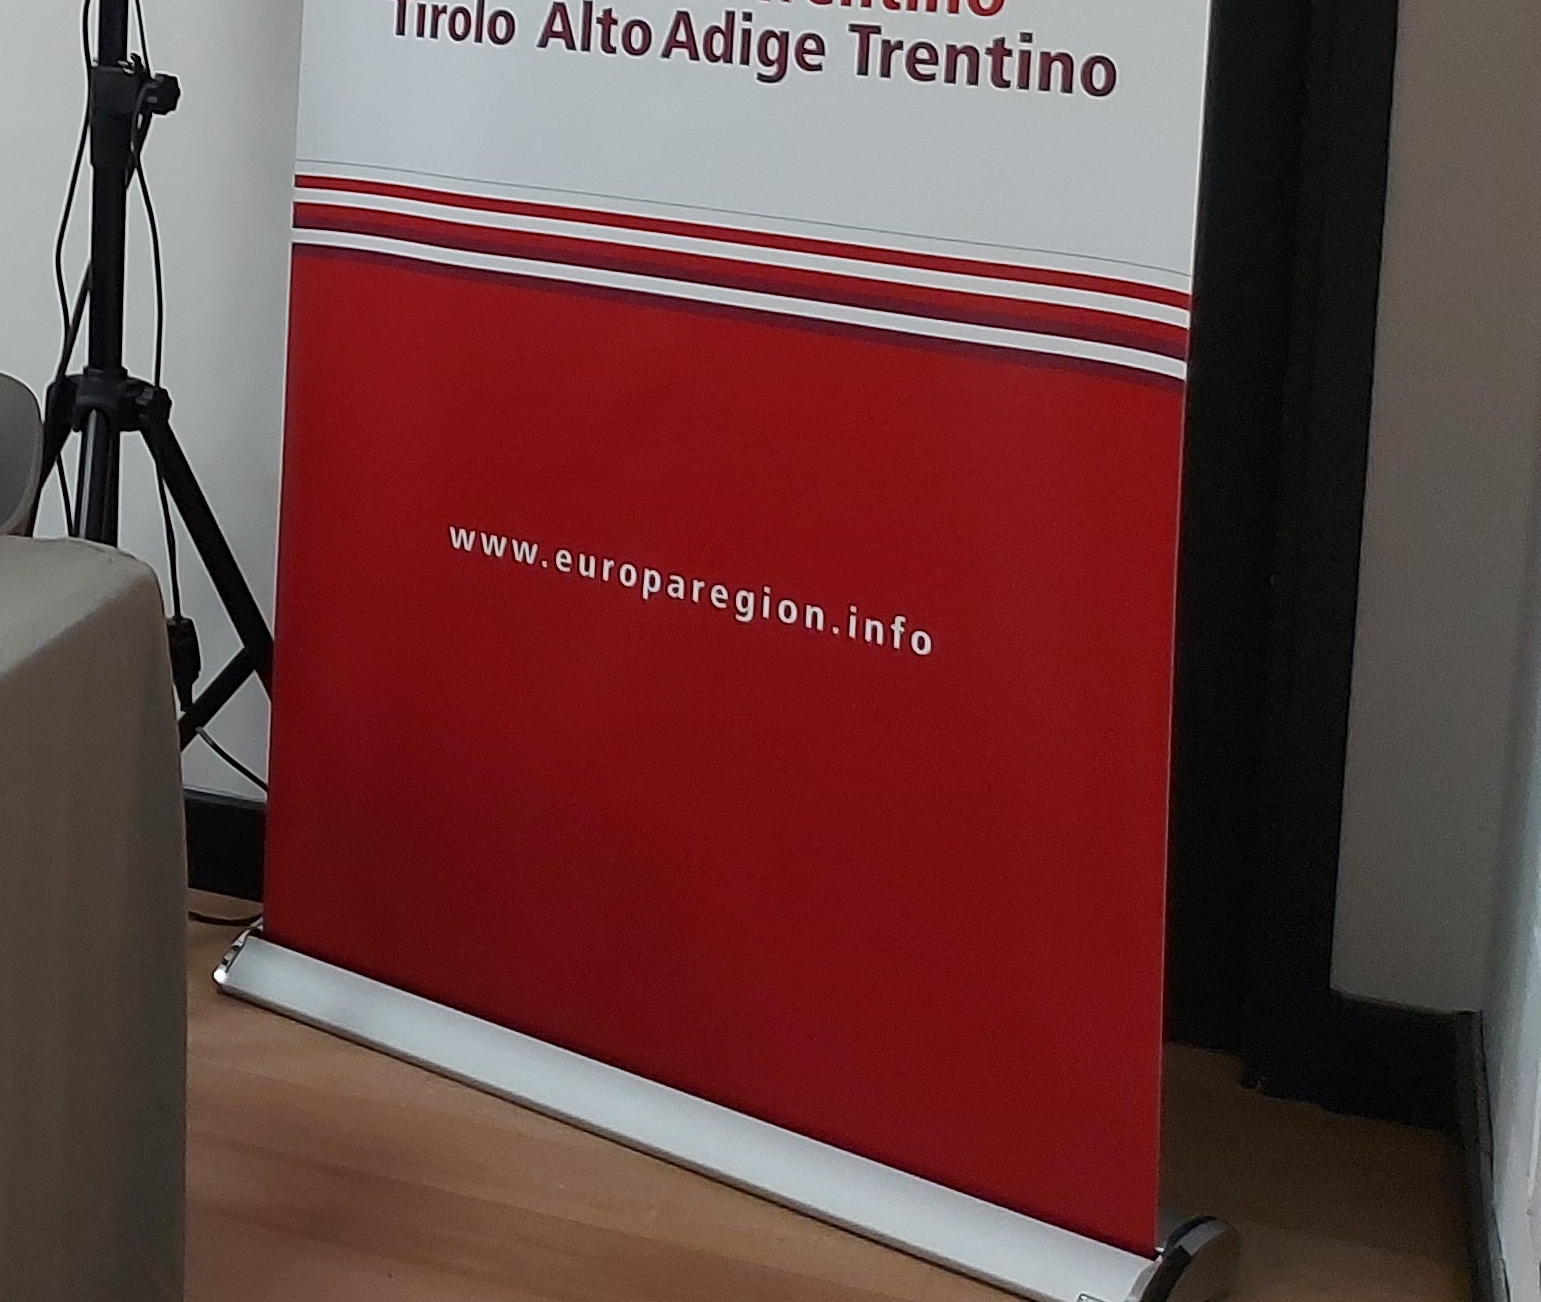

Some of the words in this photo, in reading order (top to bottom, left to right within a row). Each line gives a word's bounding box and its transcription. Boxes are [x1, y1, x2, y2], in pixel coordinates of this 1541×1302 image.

[537, 0, 652, 57] Alto
[661, 10, 826, 84] Adige
[847, 23, 1118, 98] Trentino
[449, 526, 933, 655] www.europaregion.info
